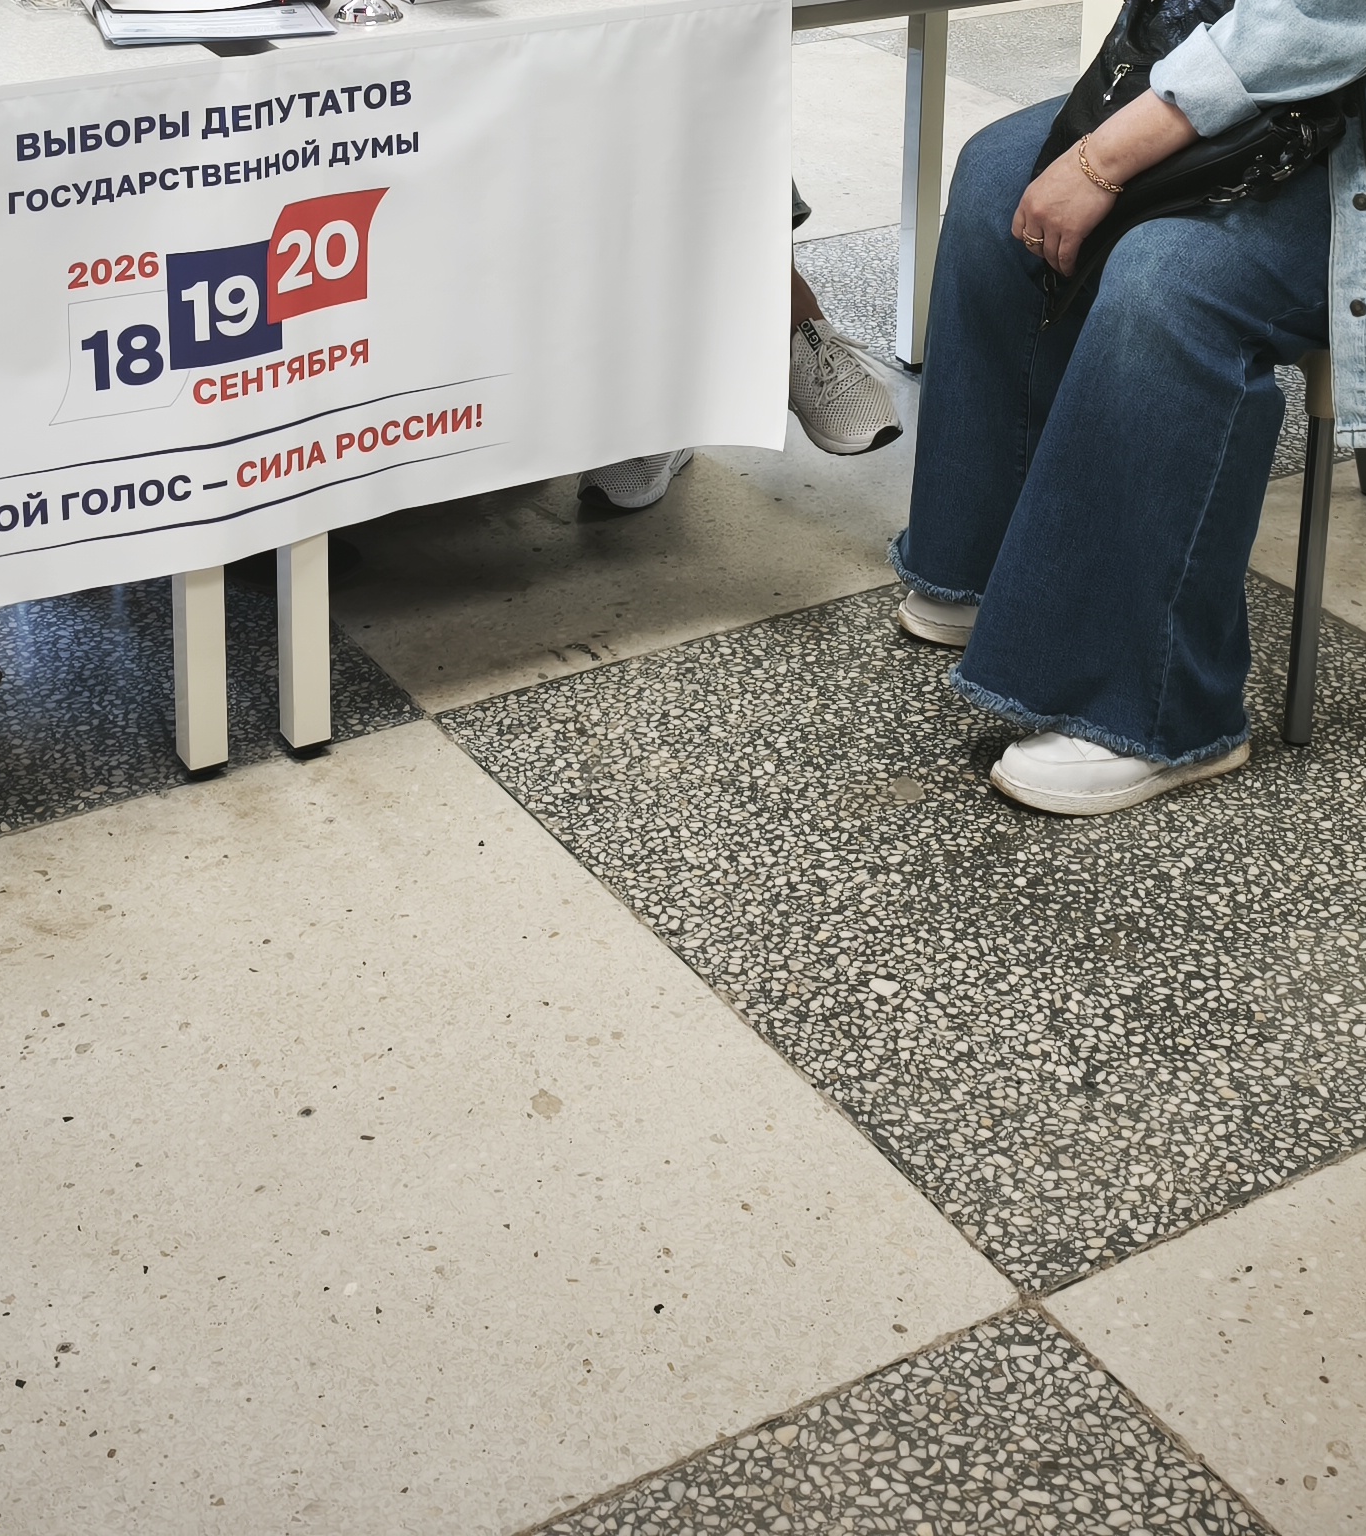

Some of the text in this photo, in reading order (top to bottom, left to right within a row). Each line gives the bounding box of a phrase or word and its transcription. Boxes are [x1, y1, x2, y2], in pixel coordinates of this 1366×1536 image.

[16, 79, 412, 162] ВЫБОРЫ ДЕПУТАТОВ
[8, 132, 419, 214] ГОСУДАРСТВЕННОЙ ДУМЫ
[68, 251, 159, 290] 2026
[82, 219, 359, 391] 18 19 20
[193, 339, 369, 405] СЕНТЯБРЯ
[61, 475, 192, 521] ГОЛОС
[236, 441, 327, 488] СИЛА
[336, 403, 482, 459] РОССИИ!
